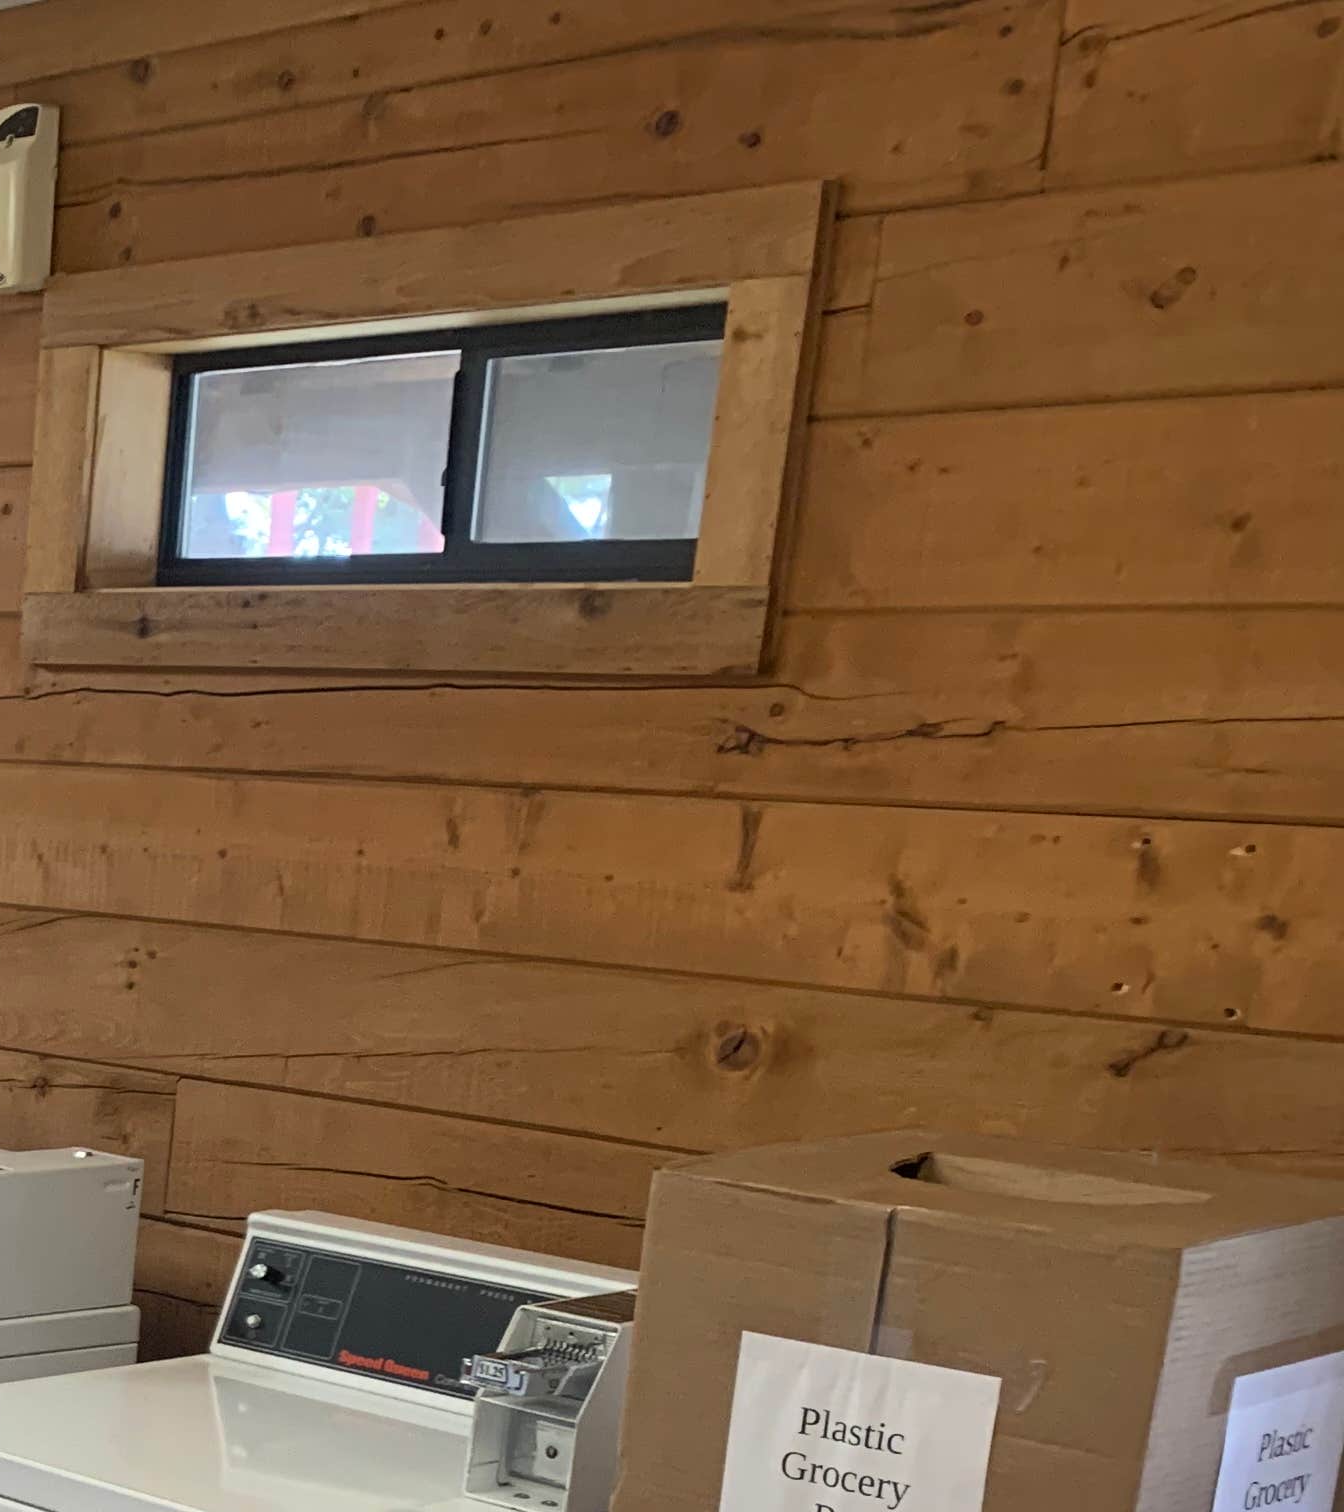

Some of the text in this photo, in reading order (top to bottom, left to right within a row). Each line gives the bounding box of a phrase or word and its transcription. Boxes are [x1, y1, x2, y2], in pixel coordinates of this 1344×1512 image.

[338, 1349, 384, 1370] Speed
[384, 1360, 430, 1381] Queen
[798, 1406, 906, 1456] Plastic
[1257, 1424, 1314, 1463] Plastic
[780, 1450, 912, 1510] Grocery
[1243, 1470, 1313, 1512] Grocery
